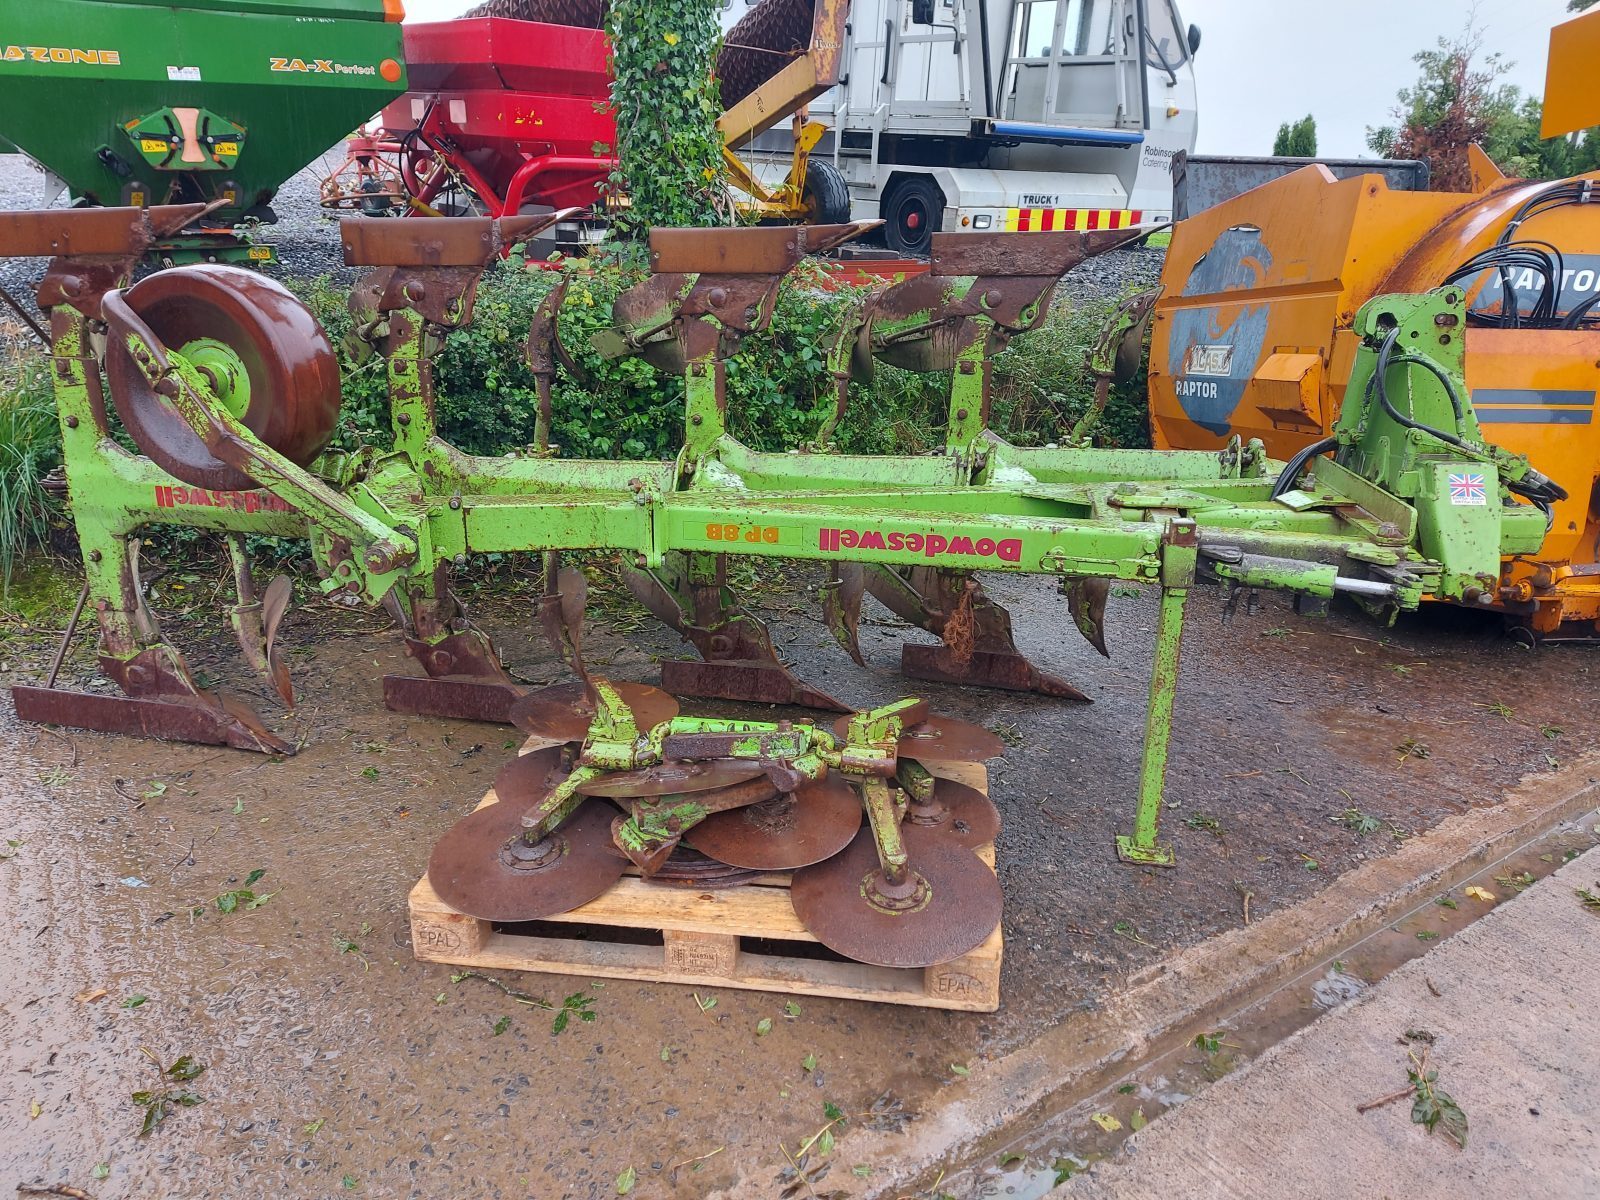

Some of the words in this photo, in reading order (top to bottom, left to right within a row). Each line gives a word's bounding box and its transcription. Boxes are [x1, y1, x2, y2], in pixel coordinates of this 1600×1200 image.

[0, 45, 121, 65] AZONE
[269, 57, 335, 74] ZA-X
[334, 63, 376, 76] Perfect
[1142, 157, 1169, 171] Catering
[1023, 195, 1053, 205] TRUCK
[1054, 195, 1060, 205] 1
[1175, 380, 1218, 399] RAPTOR
[154, 485, 300, 514] wdeswell
[705, 523, 739, 542] 8B
[744, 524, 779, 544] DP
[819, 527, 1023, 563] Dowdeswell
[419, 931, 454, 948] EPAL
